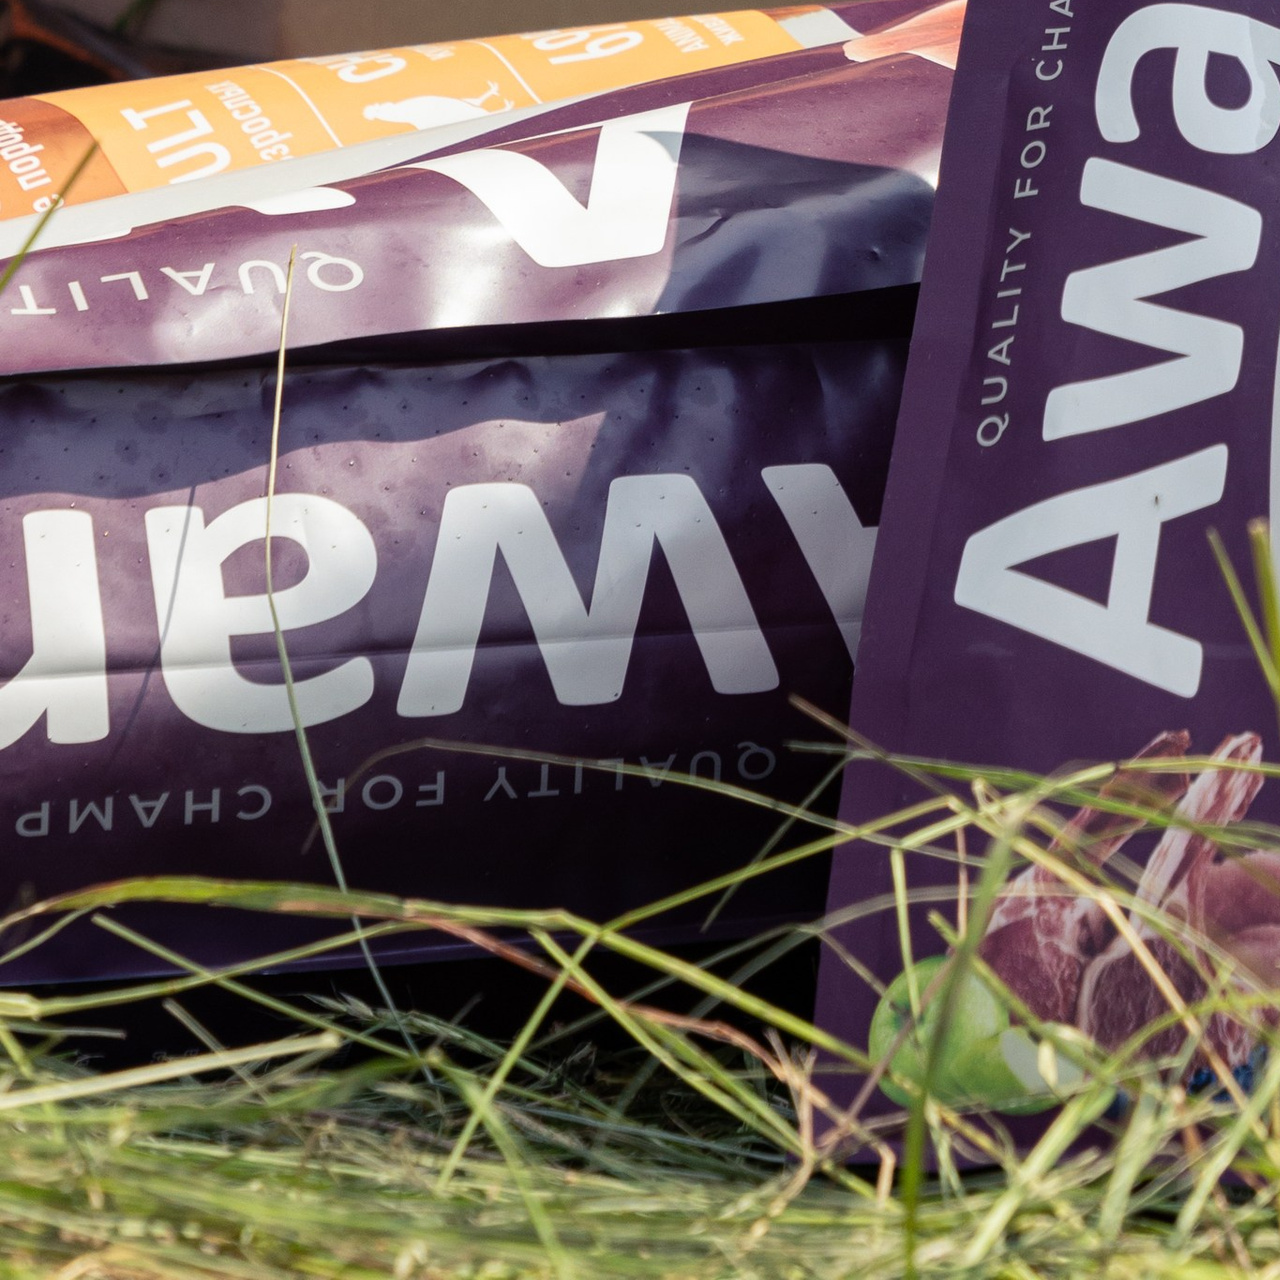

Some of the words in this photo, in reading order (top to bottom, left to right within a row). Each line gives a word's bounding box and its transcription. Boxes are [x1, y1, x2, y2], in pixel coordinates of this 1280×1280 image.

[11, 251, 364, 315] QUALIT
[977, 227, 1031, 446] QUALITY
[1014, 104, 1053, 199] FOR
[318, 770, 445, 813] FOR
[485, 741, 777, 802] QUALITY
[15, 784, 272, 837] CHAMP
